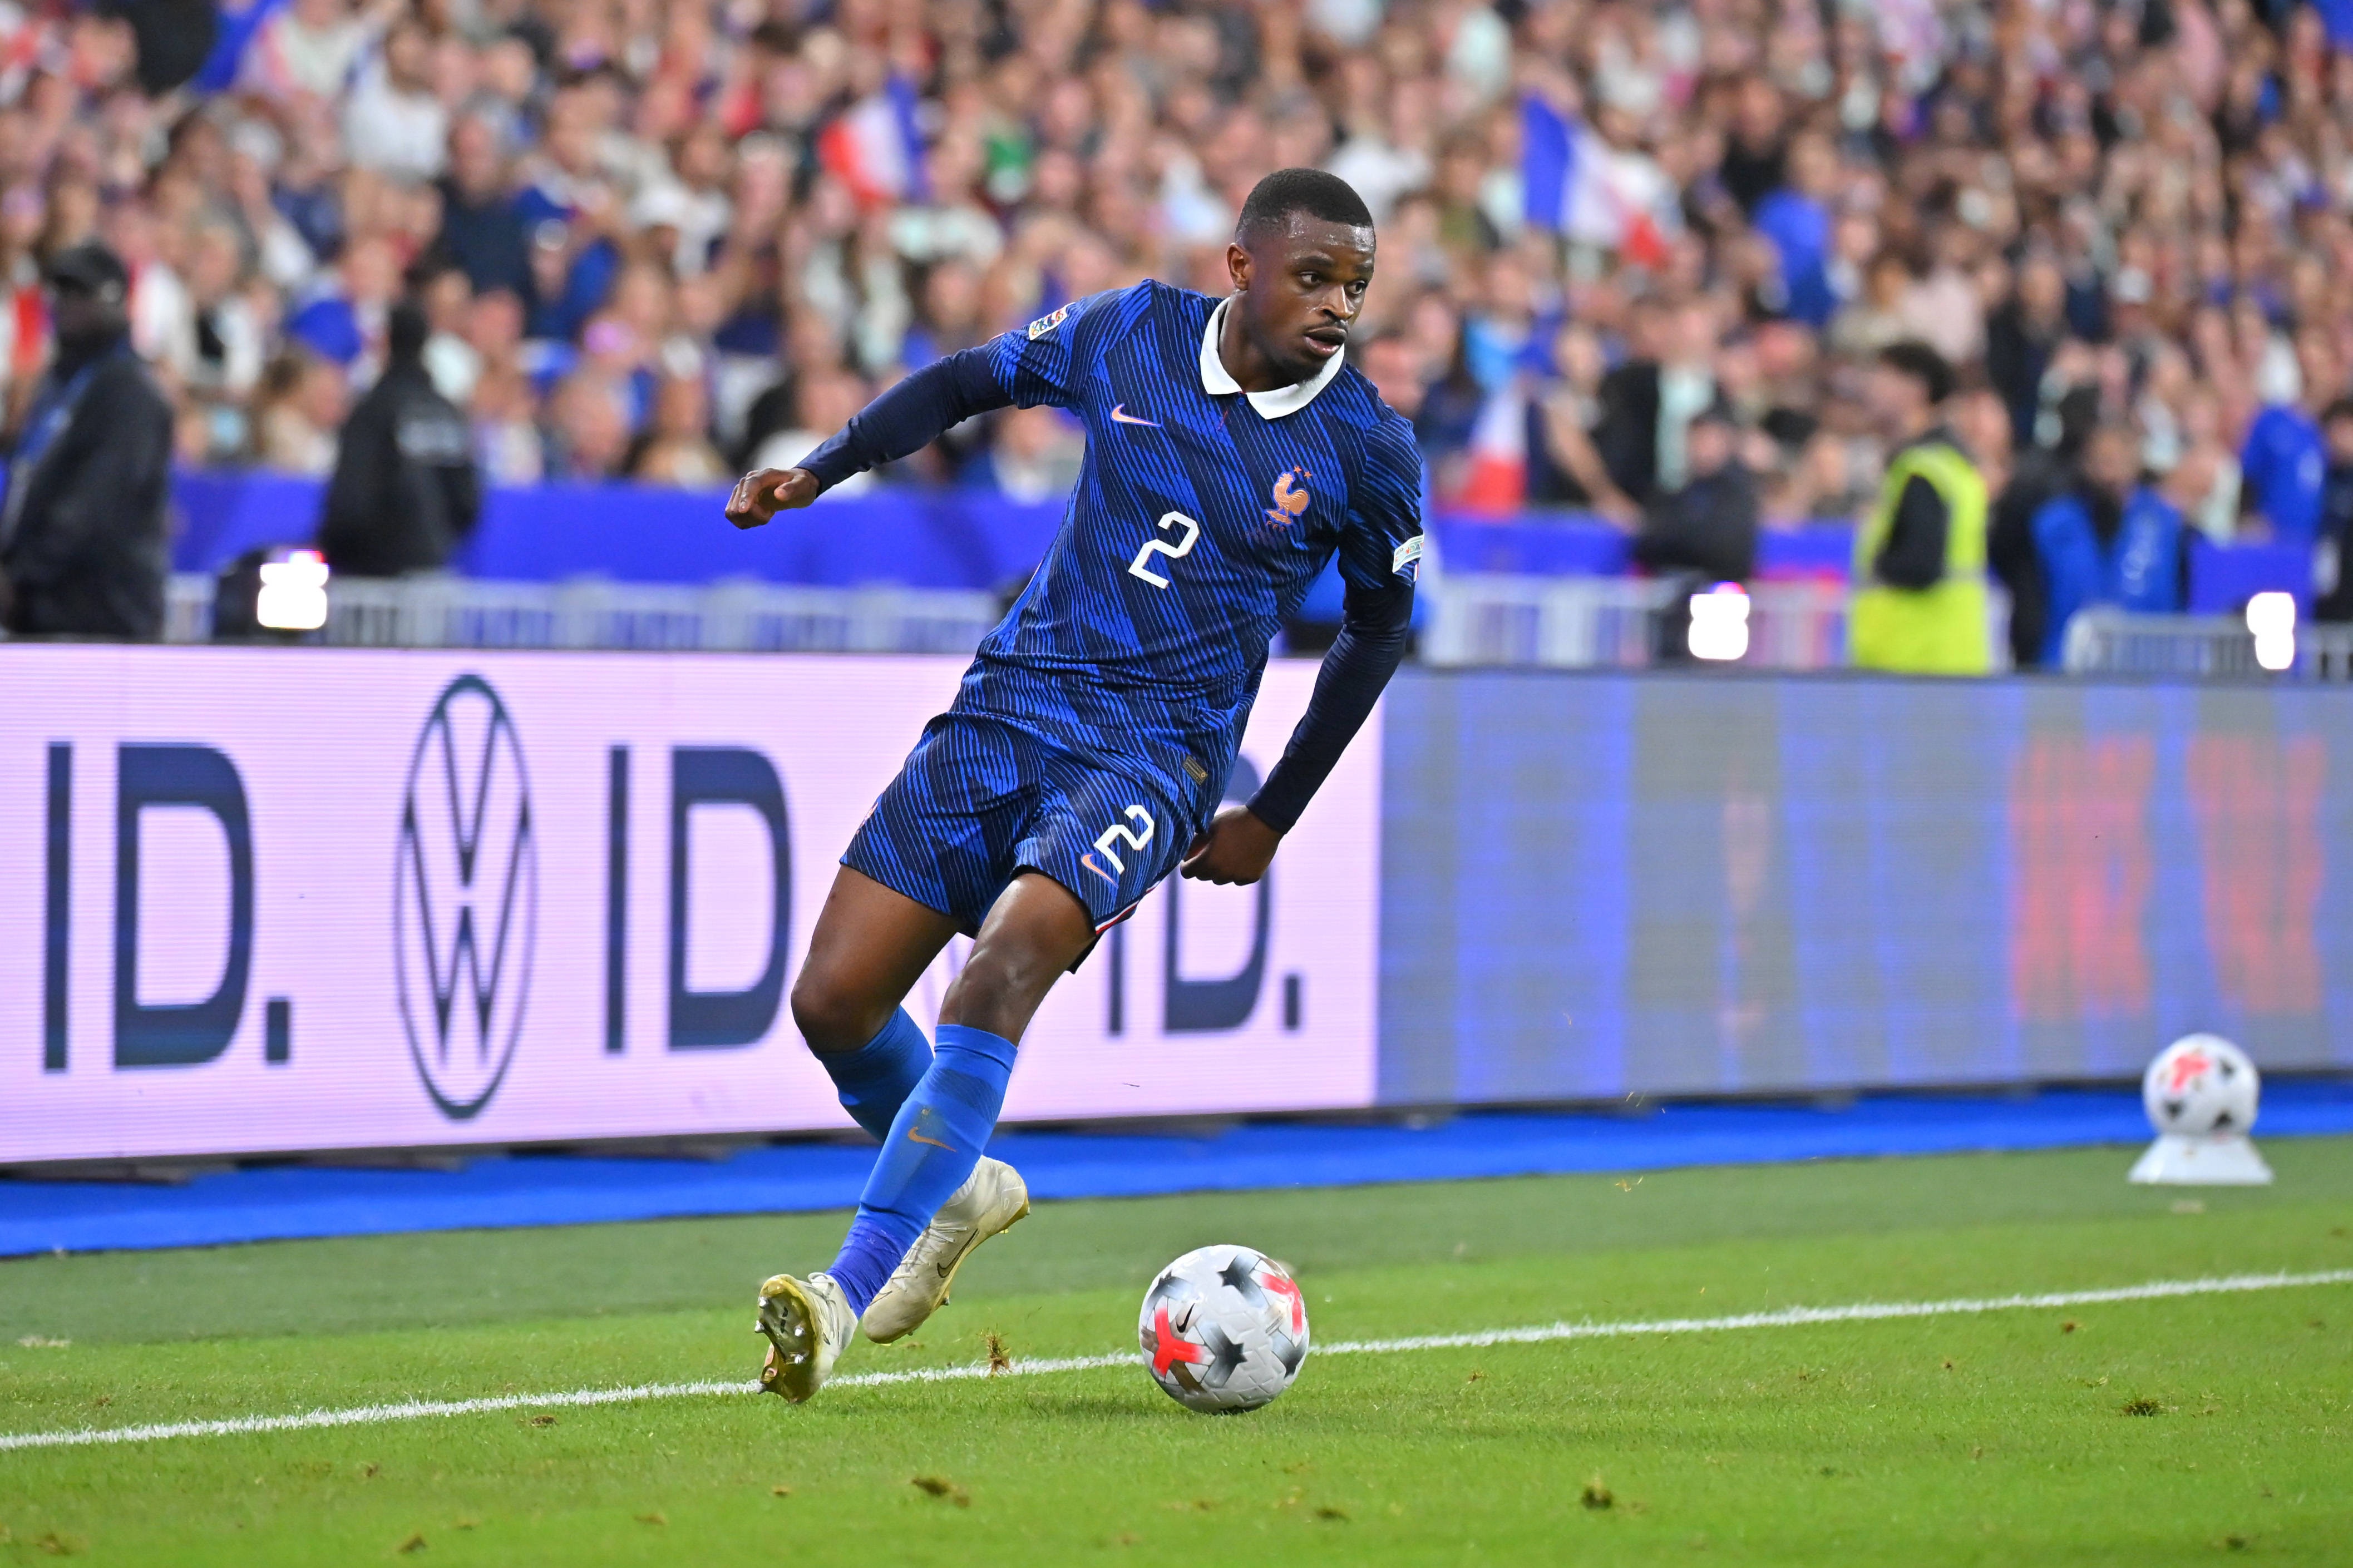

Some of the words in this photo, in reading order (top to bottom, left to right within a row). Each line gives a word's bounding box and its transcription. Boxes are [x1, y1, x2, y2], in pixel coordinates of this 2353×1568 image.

[1128, 510, 1200, 590] 2
[1094, 804, 1155, 875] 2
[44, 742, 290, 1072] ID.
